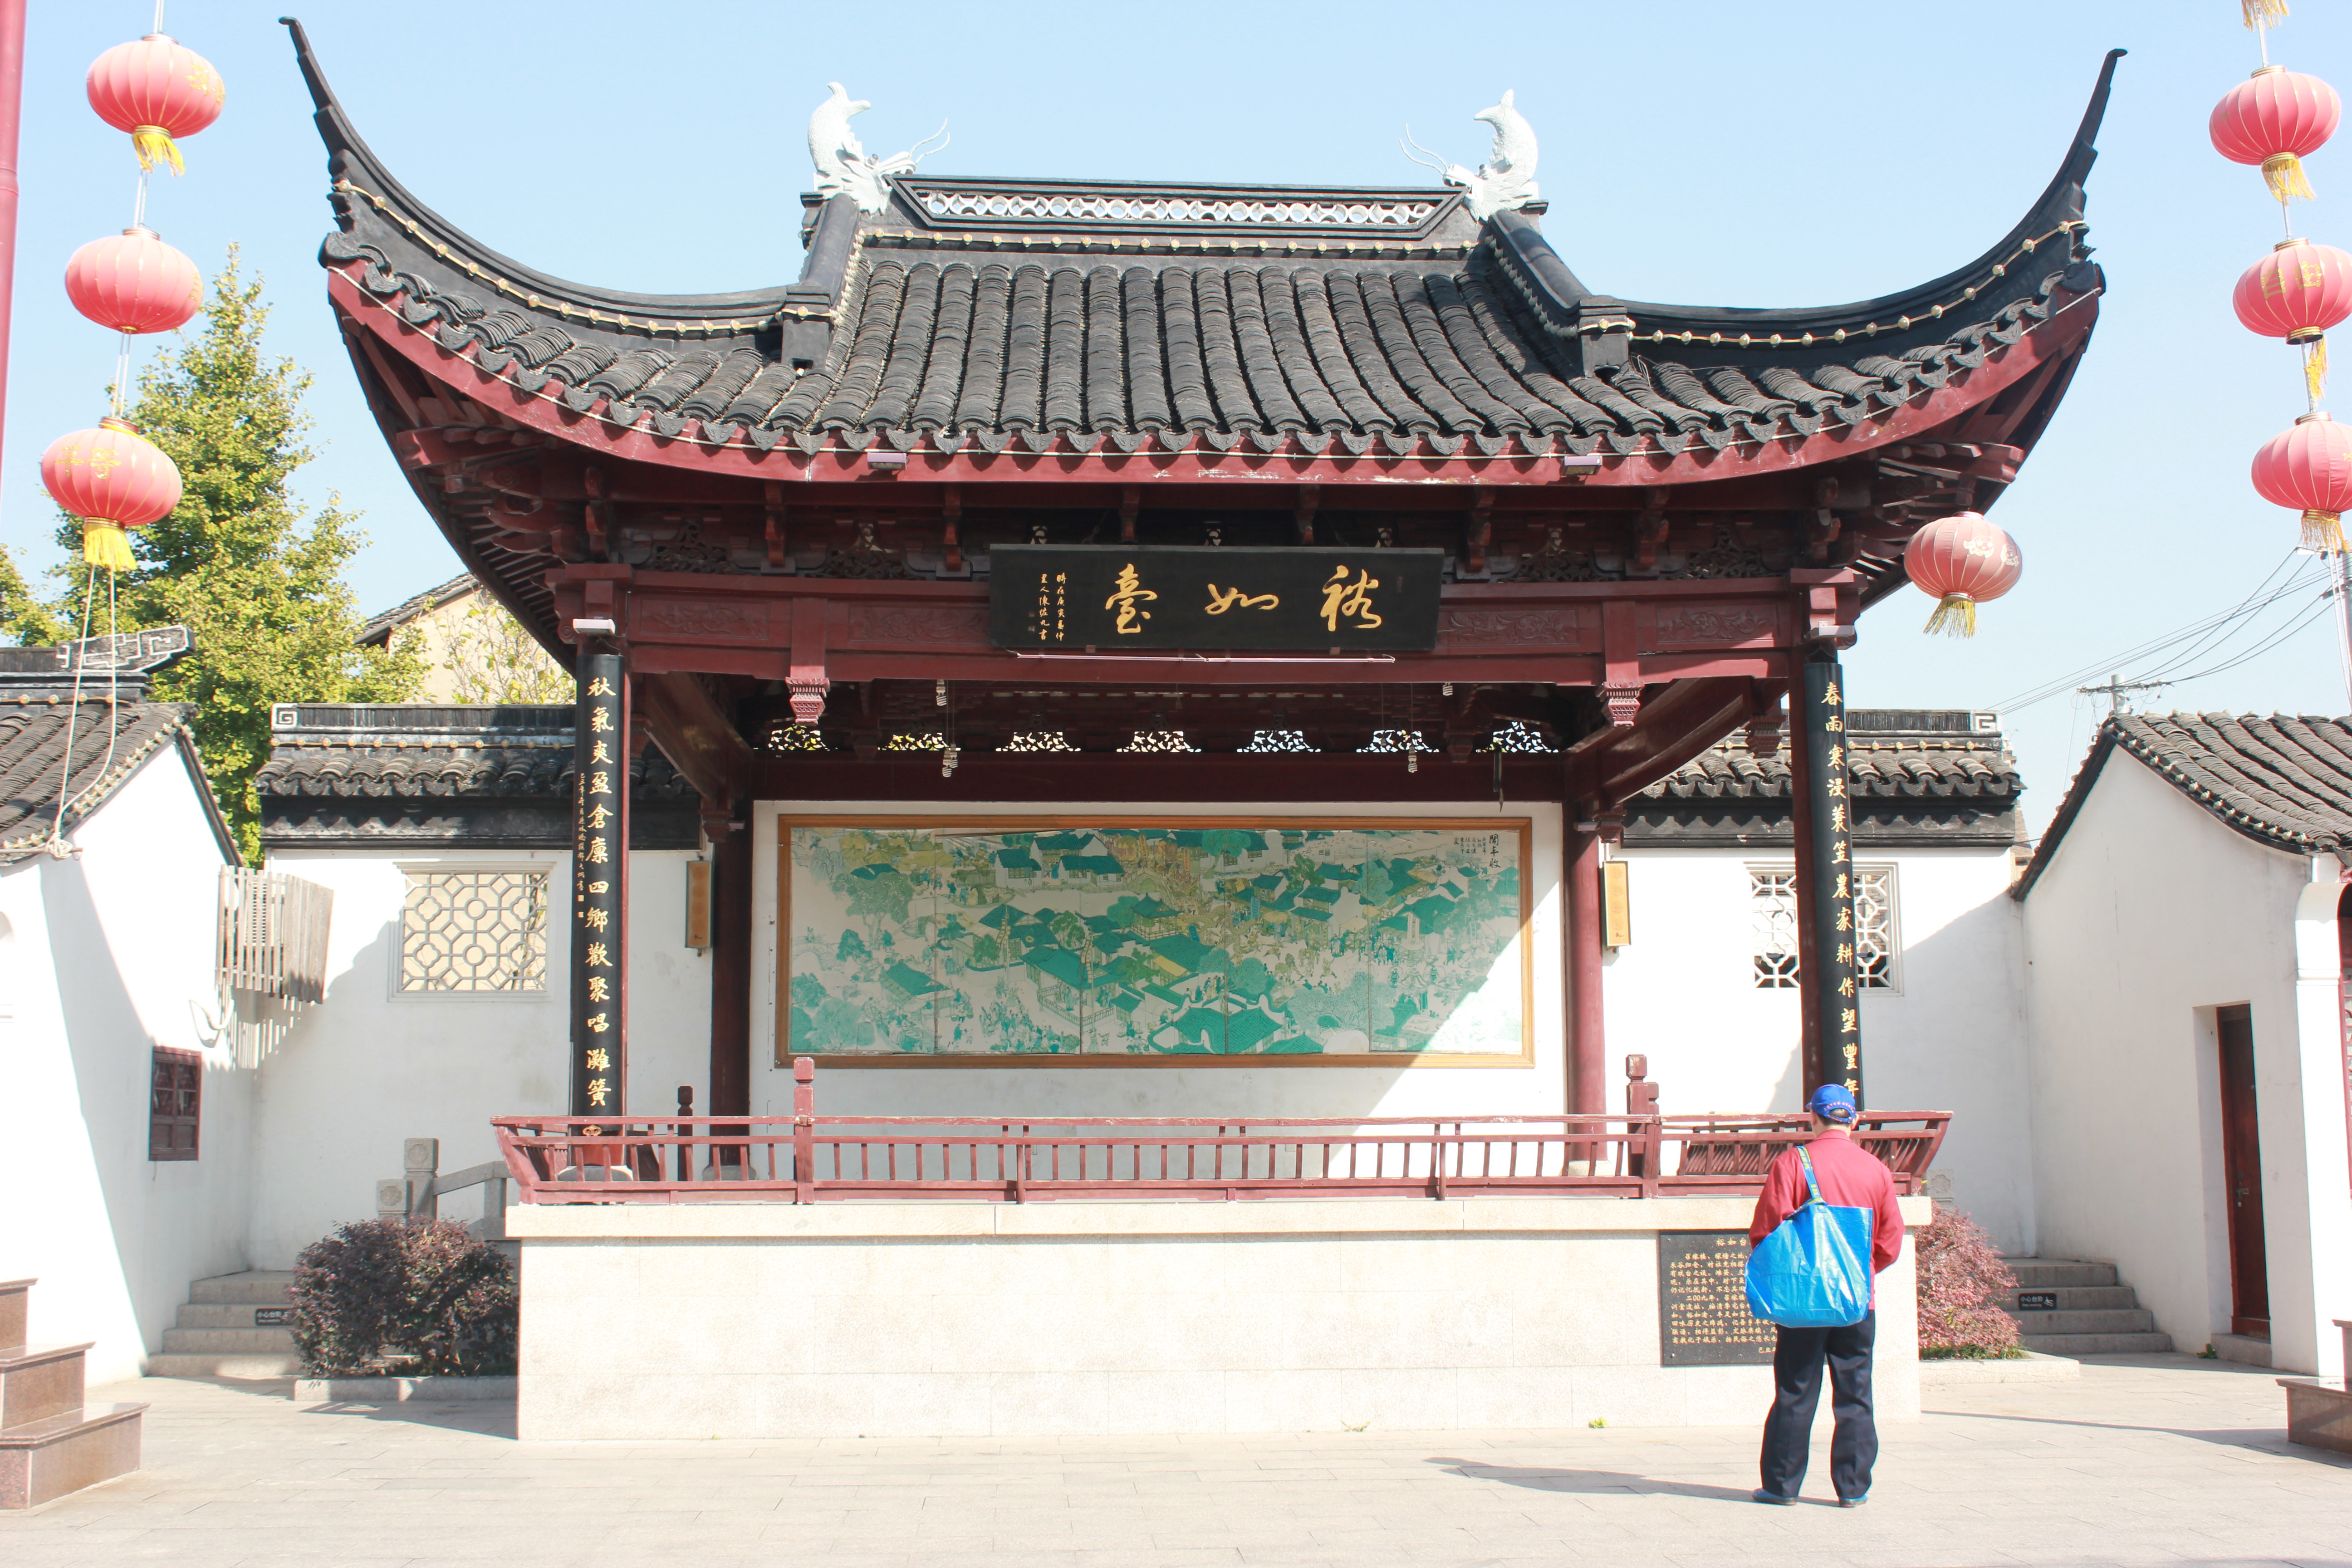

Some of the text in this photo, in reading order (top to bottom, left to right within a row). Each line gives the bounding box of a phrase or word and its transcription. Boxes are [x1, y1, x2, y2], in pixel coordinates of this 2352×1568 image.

[2261, 261, 2322, 299] 自由
[1716, 1237, 1747, 1247] 裕如台
